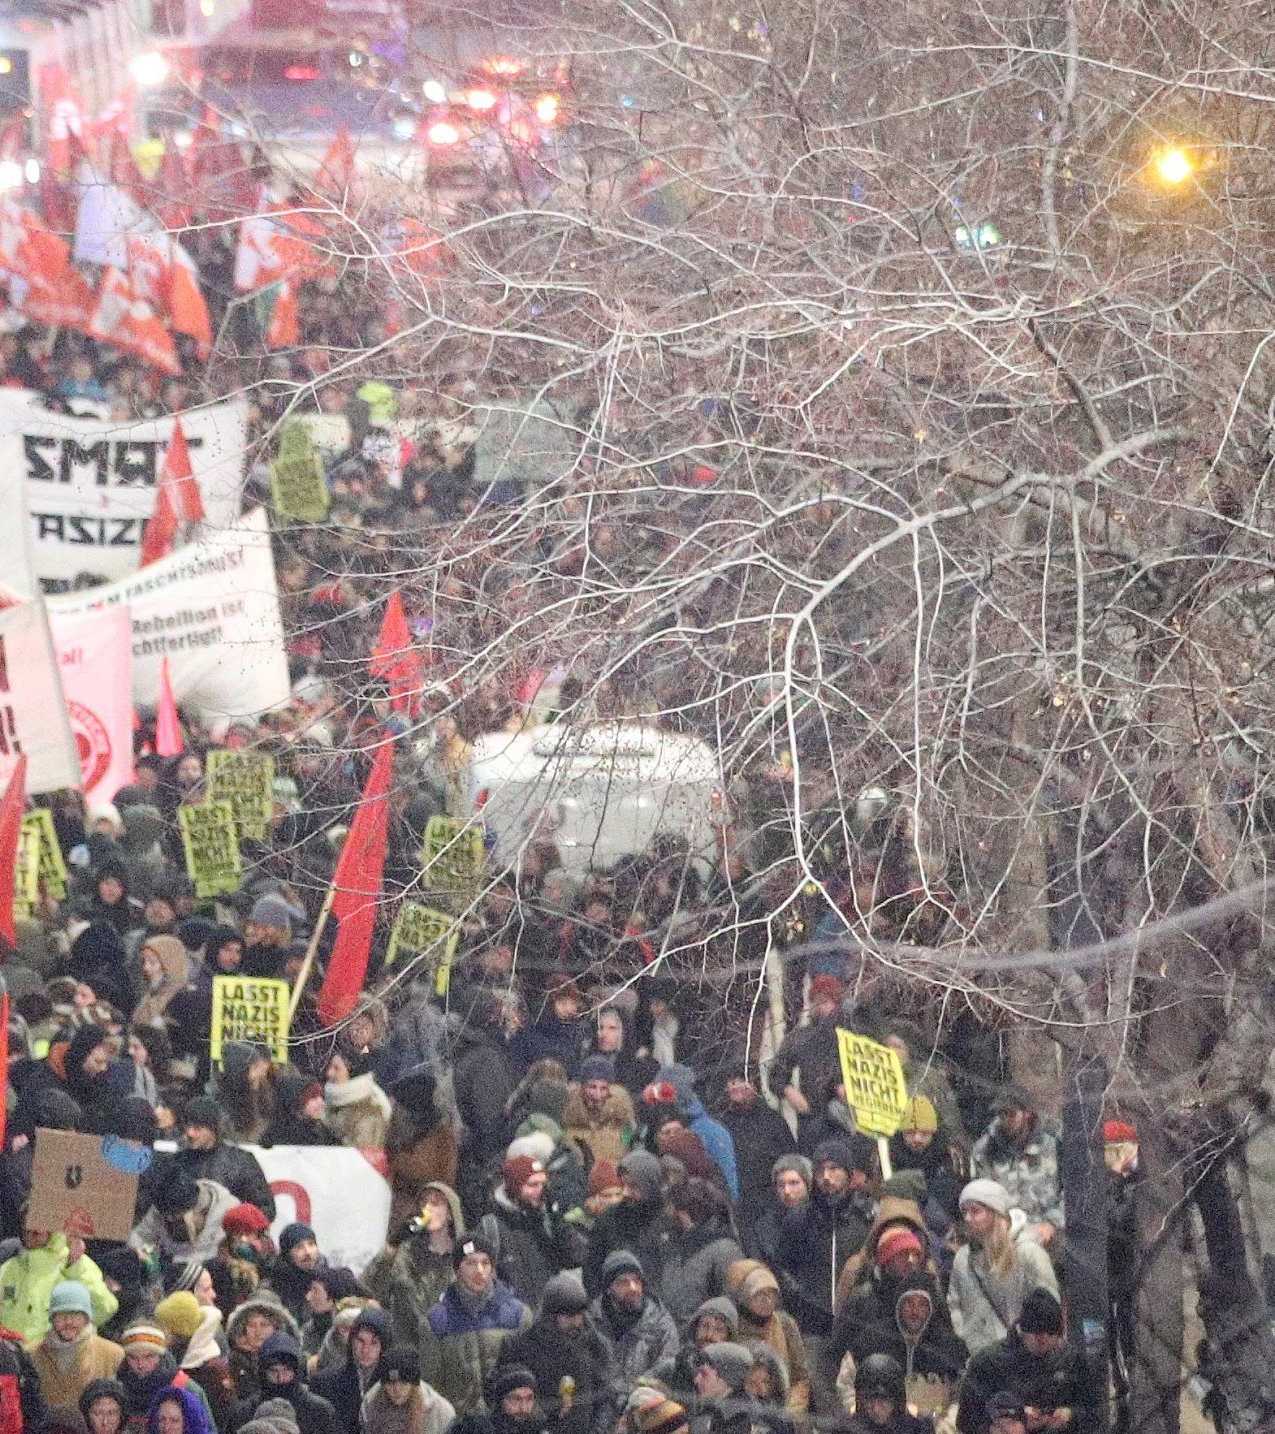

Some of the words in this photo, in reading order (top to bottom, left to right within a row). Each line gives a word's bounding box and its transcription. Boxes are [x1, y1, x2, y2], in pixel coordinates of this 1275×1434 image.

[221, 983, 281, 1002] LASST
[221, 1004, 280, 1023] NAZIS
[844, 1036, 893, 1063] LASST
[847, 1055, 897, 1087] NAZIS
[850, 1074, 900, 1105] NICHT
